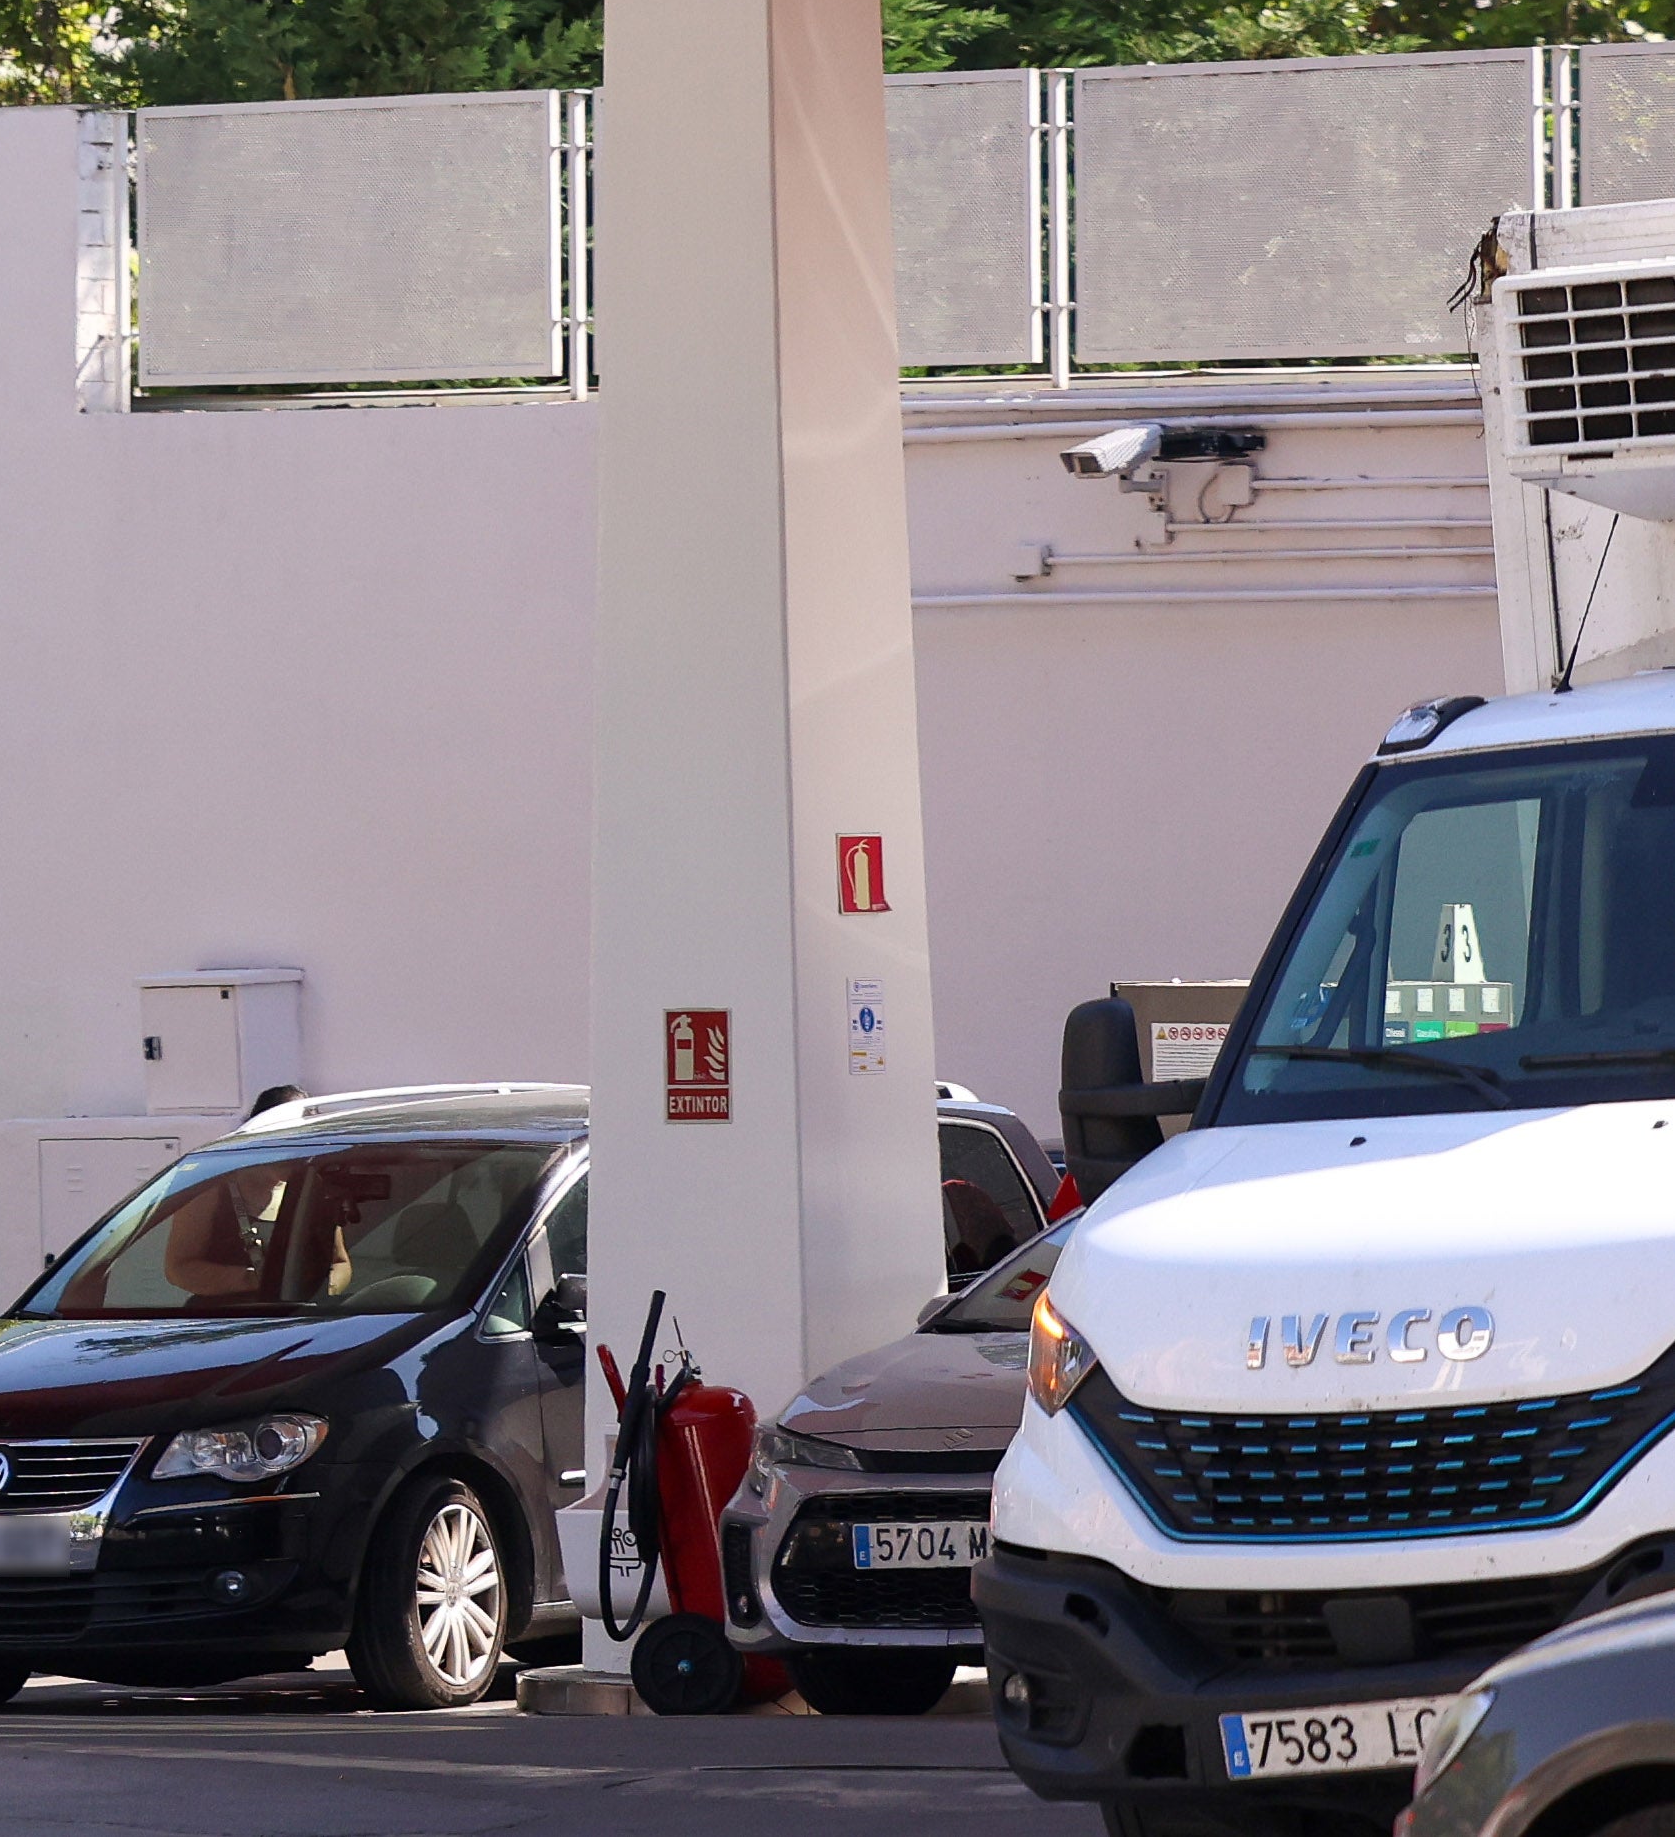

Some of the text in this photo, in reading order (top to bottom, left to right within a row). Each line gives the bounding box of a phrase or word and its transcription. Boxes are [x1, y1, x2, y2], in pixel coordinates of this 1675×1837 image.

[1462, 924, 1471, 962] 3
[669, 1095, 727, 1113] EXTINTOR
[1247, 1305, 1496, 1369] IVECO
[876, 1527, 956, 1561] 5704
[1251, 1708, 1437, 1768] 7583 LC
